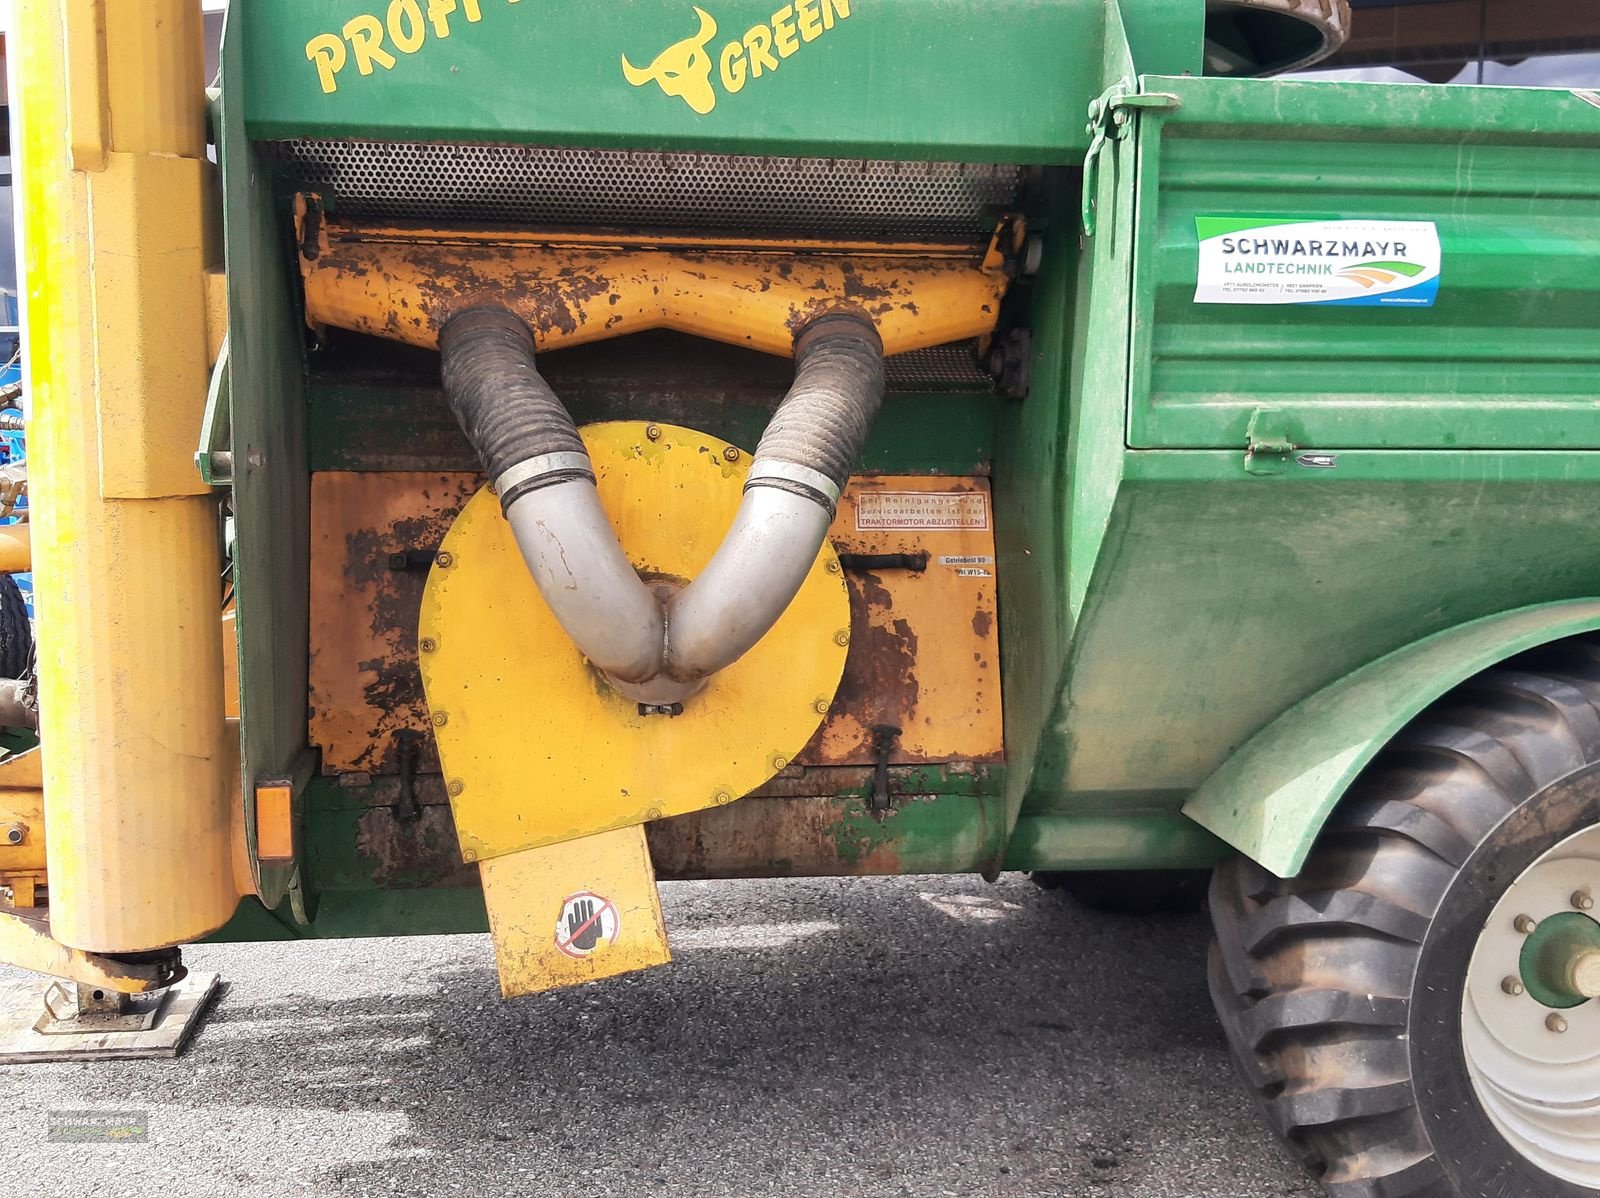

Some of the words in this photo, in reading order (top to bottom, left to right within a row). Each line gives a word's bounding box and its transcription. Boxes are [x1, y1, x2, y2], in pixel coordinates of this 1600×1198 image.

[719, 0, 850, 93] GREEN
[1222, 238, 1407, 257] SCHWARZMAYR
[1224, 262, 1333, 275] LANDTECHNIK
[860, 507, 942, 515] Servicearbeiten
[947, 507, 961, 515] ist
[966, 507, 983, 515] der
[860, 518, 925, 526] TRAKTORMOTOR
